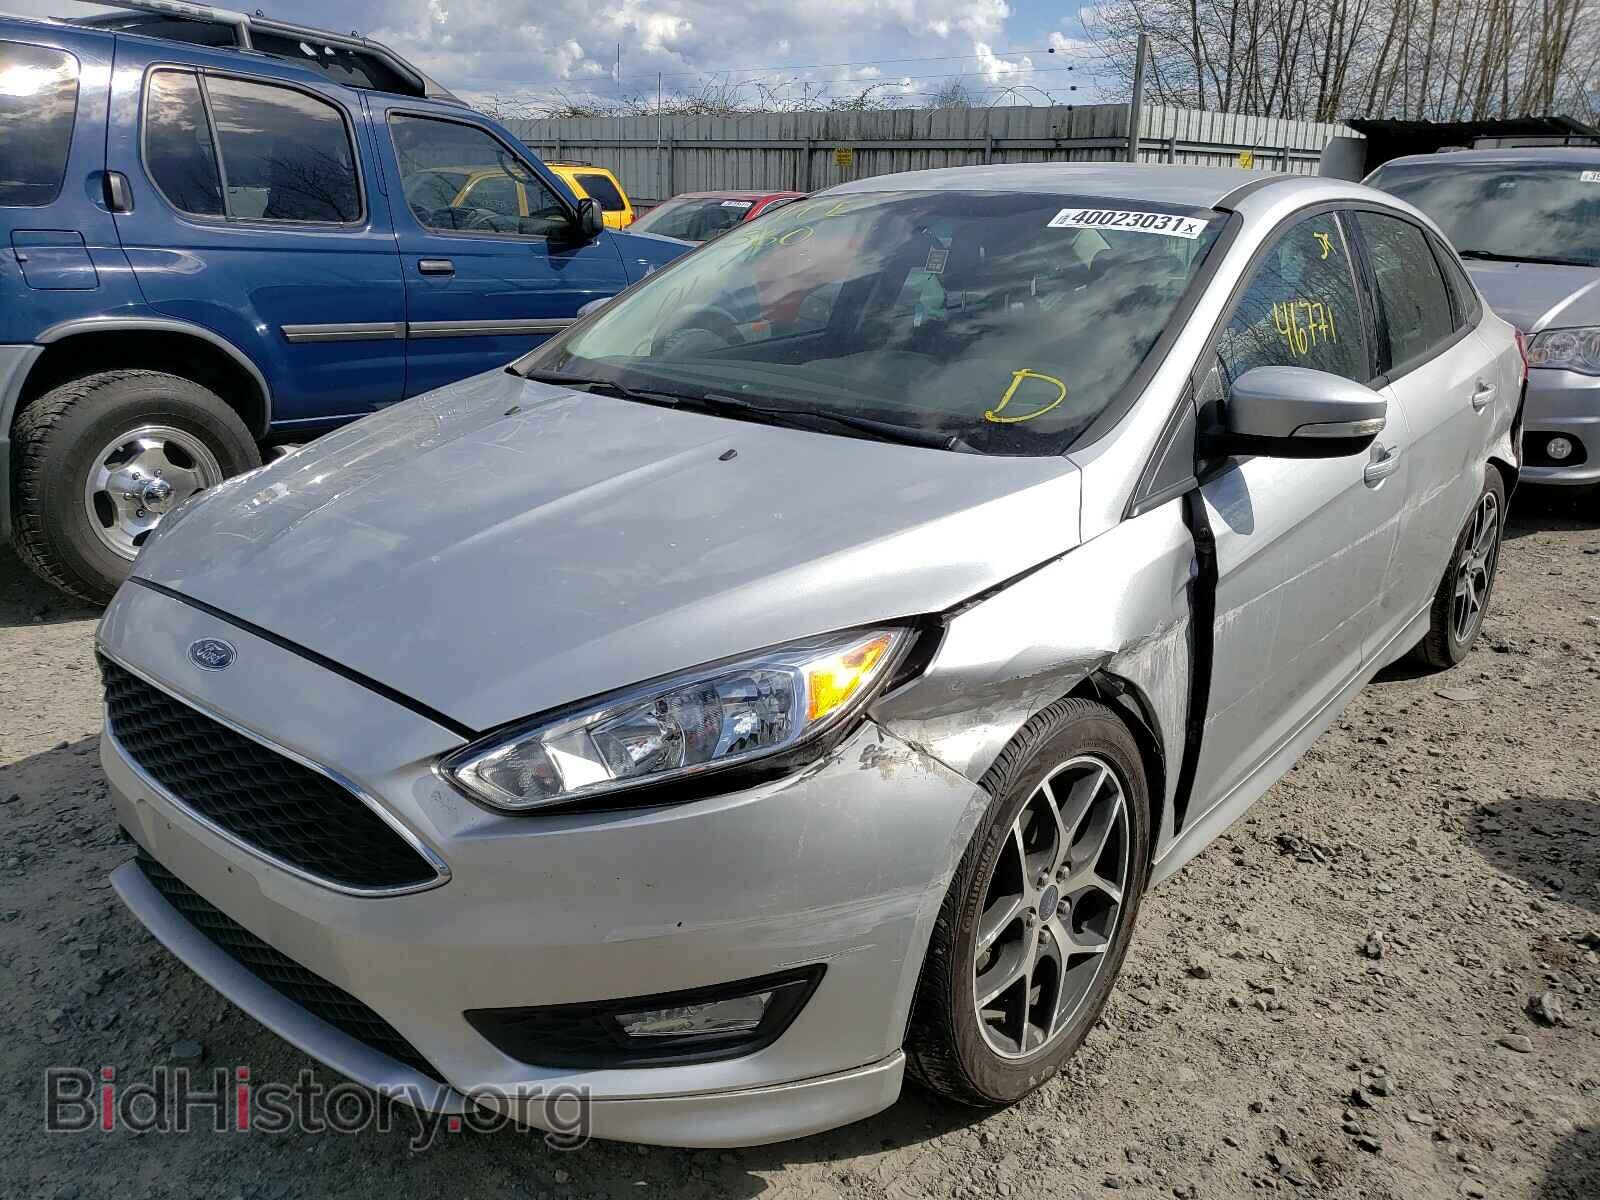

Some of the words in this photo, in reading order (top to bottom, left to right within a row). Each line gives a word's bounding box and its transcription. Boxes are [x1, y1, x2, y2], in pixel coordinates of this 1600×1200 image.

[1071, 210, 1185, 232] 40023031
[1273, 299, 1337, 358] 46771
[984, 368, 1067, 423] D
